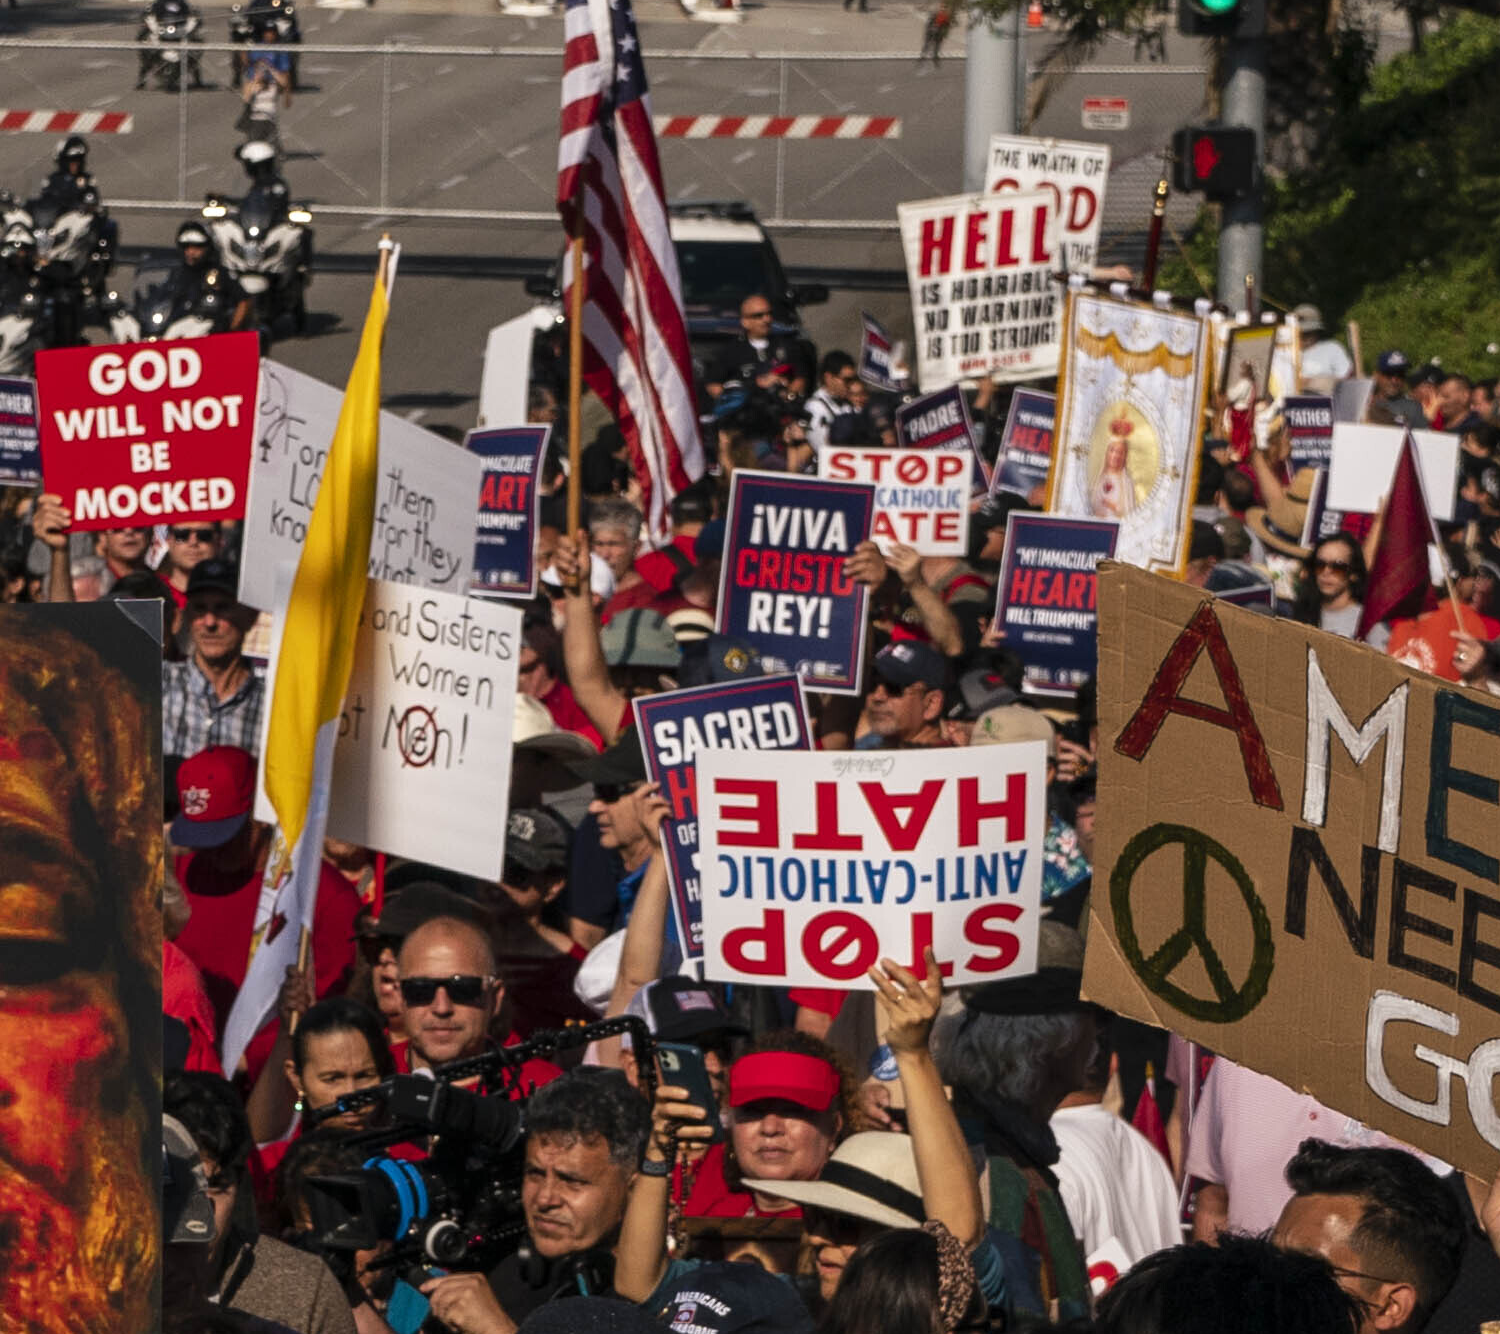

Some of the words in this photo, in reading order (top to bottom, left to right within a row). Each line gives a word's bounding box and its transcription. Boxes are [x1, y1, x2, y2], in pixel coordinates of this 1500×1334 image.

[994, 148, 1019, 169] THE
[918, 206, 1052, 277] HELL
[921, 283, 941, 305] IS
[952, 271, 1052, 301] HORRIBLE
[925, 309, 949, 331] NO
[961, 296, 1055, 327] WARNING
[927, 336, 942, 358] IS
[951, 332, 980, 354] TOO
[88, 347, 202, 396] GOD
[54, 404, 146, 442] WILL
[161, 395, 244, 434] NOT
[130, 441, 172, 474] BE
[829, 452, 964, 486] STOP
[73, 477, 236, 522] MOCKED
[387, 468, 437, 521] them
[377, 501, 410, 550] for
[415, 520, 462, 585] they
[750, 504, 849, 553] ¡VIVA
[872, 512, 960, 544] ATE
[372, 596, 411, 637] and
[420, 600, 512, 661] Sisters
[747, 592, 832, 639] REY!
[389, 643, 493, 709] Women
[653, 700, 799, 766] SACRED
[714, 773, 1027, 851] HATE
[718, 849, 1027, 905] ANTI-CATHOLIC
[720, 902, 1024, 981] STOP
[673, 1291, 732, 1317] AMERICANS
